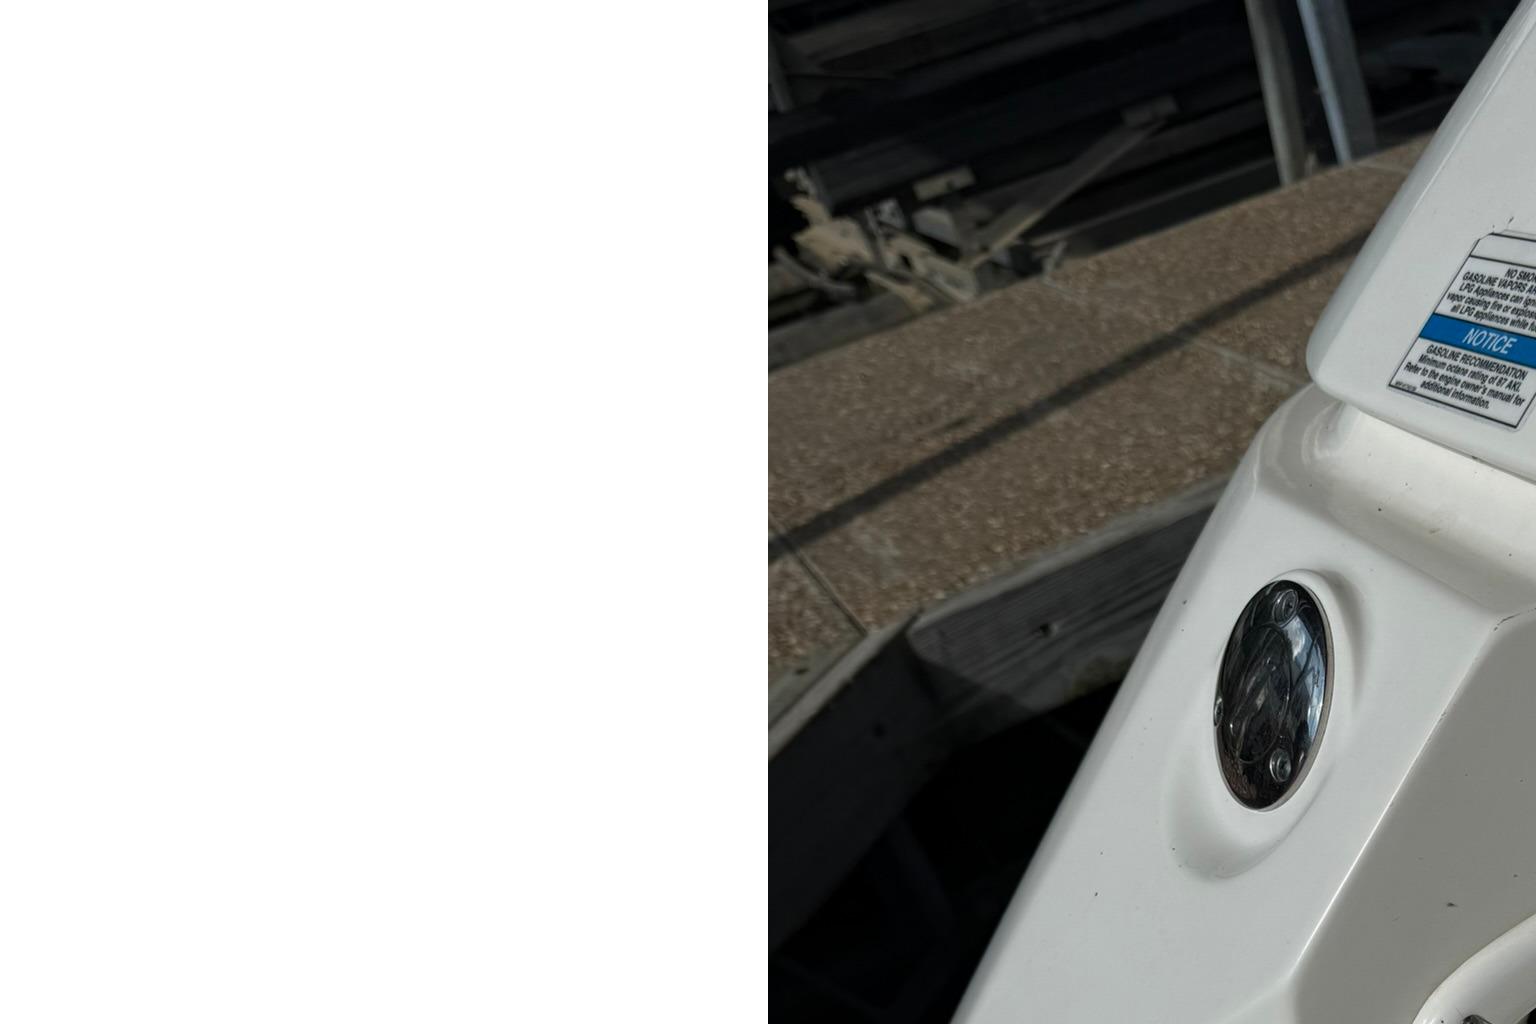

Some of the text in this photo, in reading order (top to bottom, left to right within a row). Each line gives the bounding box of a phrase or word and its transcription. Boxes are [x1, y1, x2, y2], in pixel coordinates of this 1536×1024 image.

[1463, 271, 1499, 287] GASOLINE
[1498, 278, 1528, 293] VAPORS
[1505, 268, 1519, 280] NO
[1447, 292, 1466, 303] vapor
[1465, 296, 1492, 310] causing
[1490, 300, 1503, 312] fire
[1502, 304, 1513, 313] or
[1459, 282, 1476, 294] LPG
[1473, 285, 1511, 302] Appliances
[1510, 294, 1524, 305] can
[1451, 303, 1462, 314] all
[1459, 305, 1476, 317] LPG
[1474, 309, 1510, 326] appliances
[1510, 317, 1529, 330] while
[1464, 328, 1517, 354] NOTICE
[1418, 354, 1447, 370] Minimum
[1446, 363, 1469, 377] octane
[1468, 370, 1489, 384] rating
[1488, 375, 1499, 385] of
[1496, 376, 1509, 388] 87
[1427, 344, 1528, 381] GASOLINE RECOMMENDATION
[1404, 361, 1422, 375] Refer
[1421, 366, 1429, 377] to
[1428, 368, 1440, 382] the
[1439, 373, 1462, 387] engine
[1487, 388, 1516, 403] manual
[1513, 394, 1526, 407] for
[1421, 380, 1454, 397] additional
[1451, 389, 1490, 409] information.
